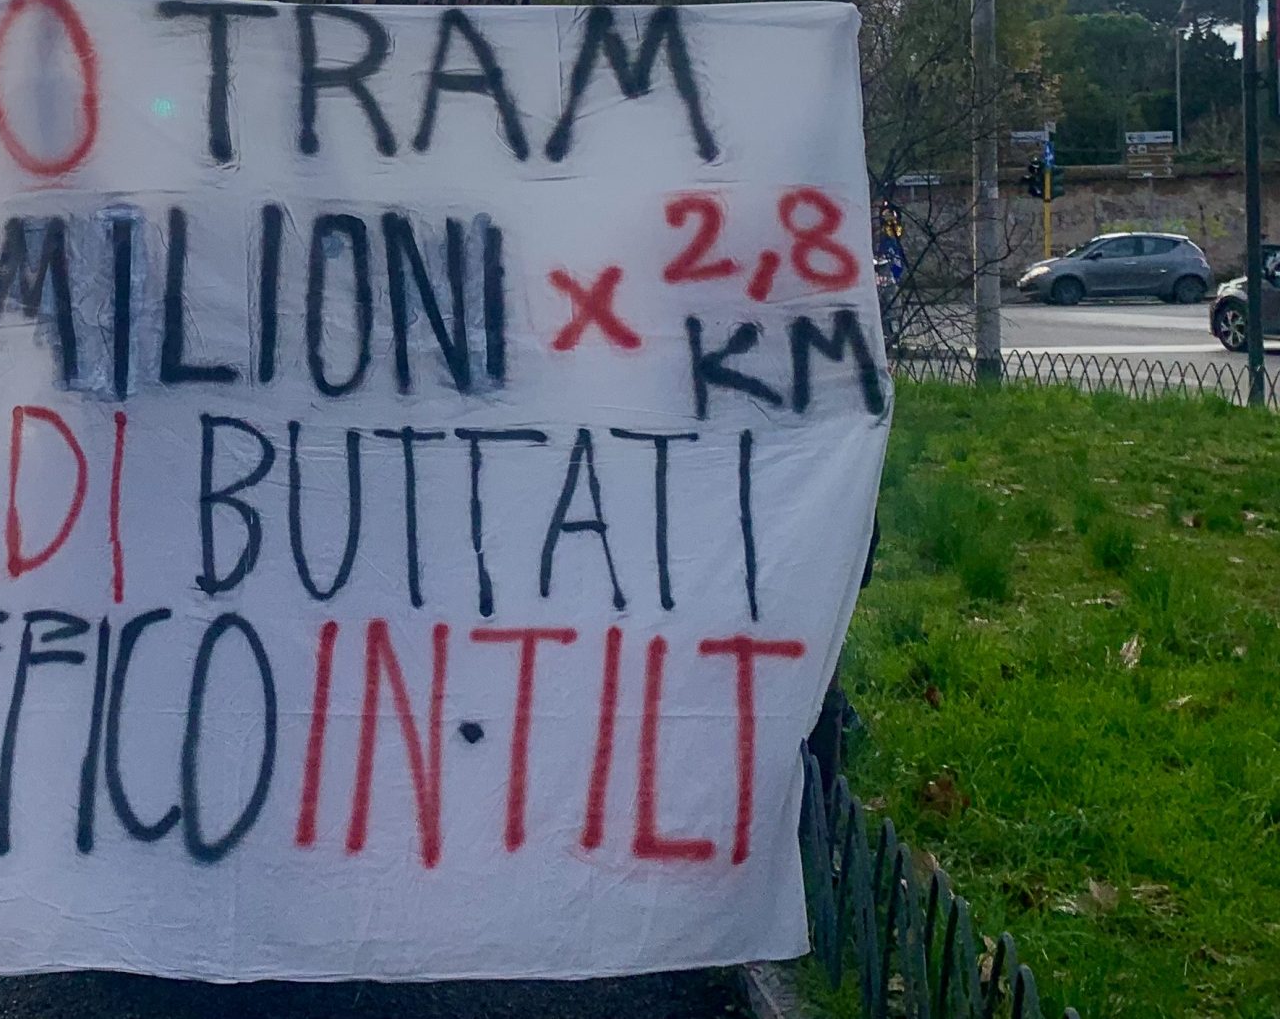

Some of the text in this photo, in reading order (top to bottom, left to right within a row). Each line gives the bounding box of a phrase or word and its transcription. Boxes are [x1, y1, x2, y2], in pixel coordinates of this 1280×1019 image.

[154, 0, 718, 165] TRAM
[663, 187, 860, 302] 2,8
[684, 309, 885, 420] KM
[194, 414, 759, 621] BUTTATI
